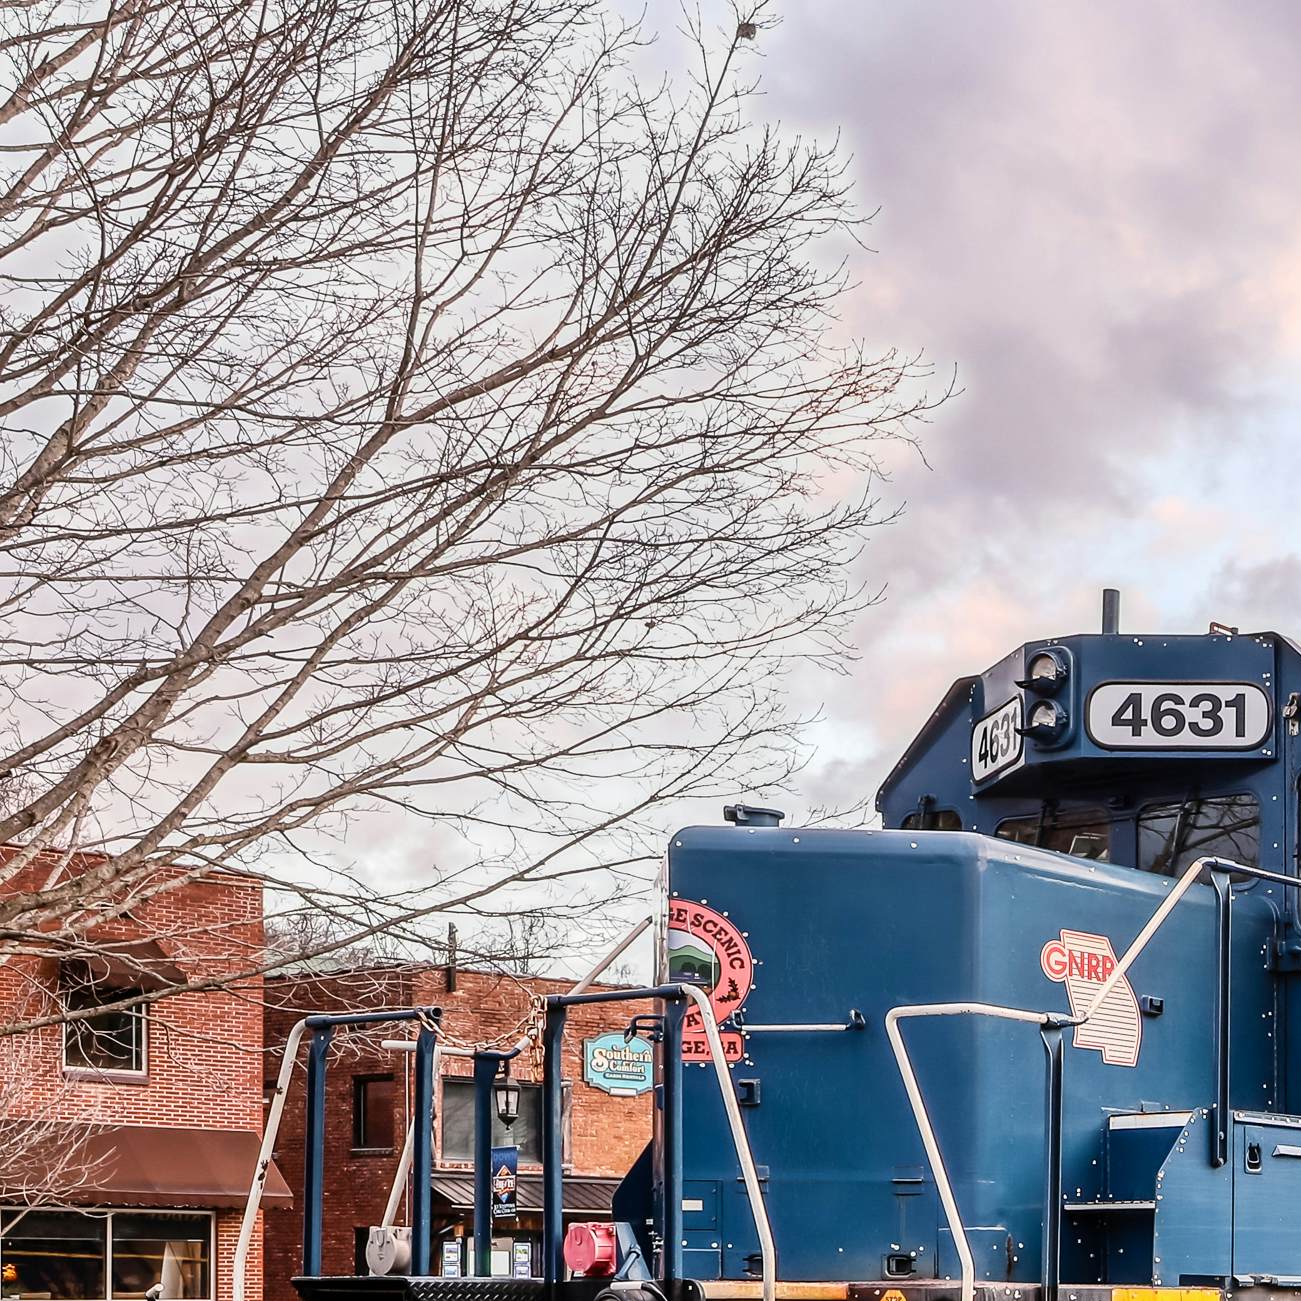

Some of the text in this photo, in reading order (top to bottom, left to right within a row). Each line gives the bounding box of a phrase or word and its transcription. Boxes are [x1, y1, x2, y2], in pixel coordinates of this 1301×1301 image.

[978, 707, 1018, 769] 4631
[1111, 692, 1246, 738] 4631
[690, 912, 745, 970] SCENIC
[591, 1045, 652, 1072] Southern
[608, 1060, 645, 1073] Comfort
